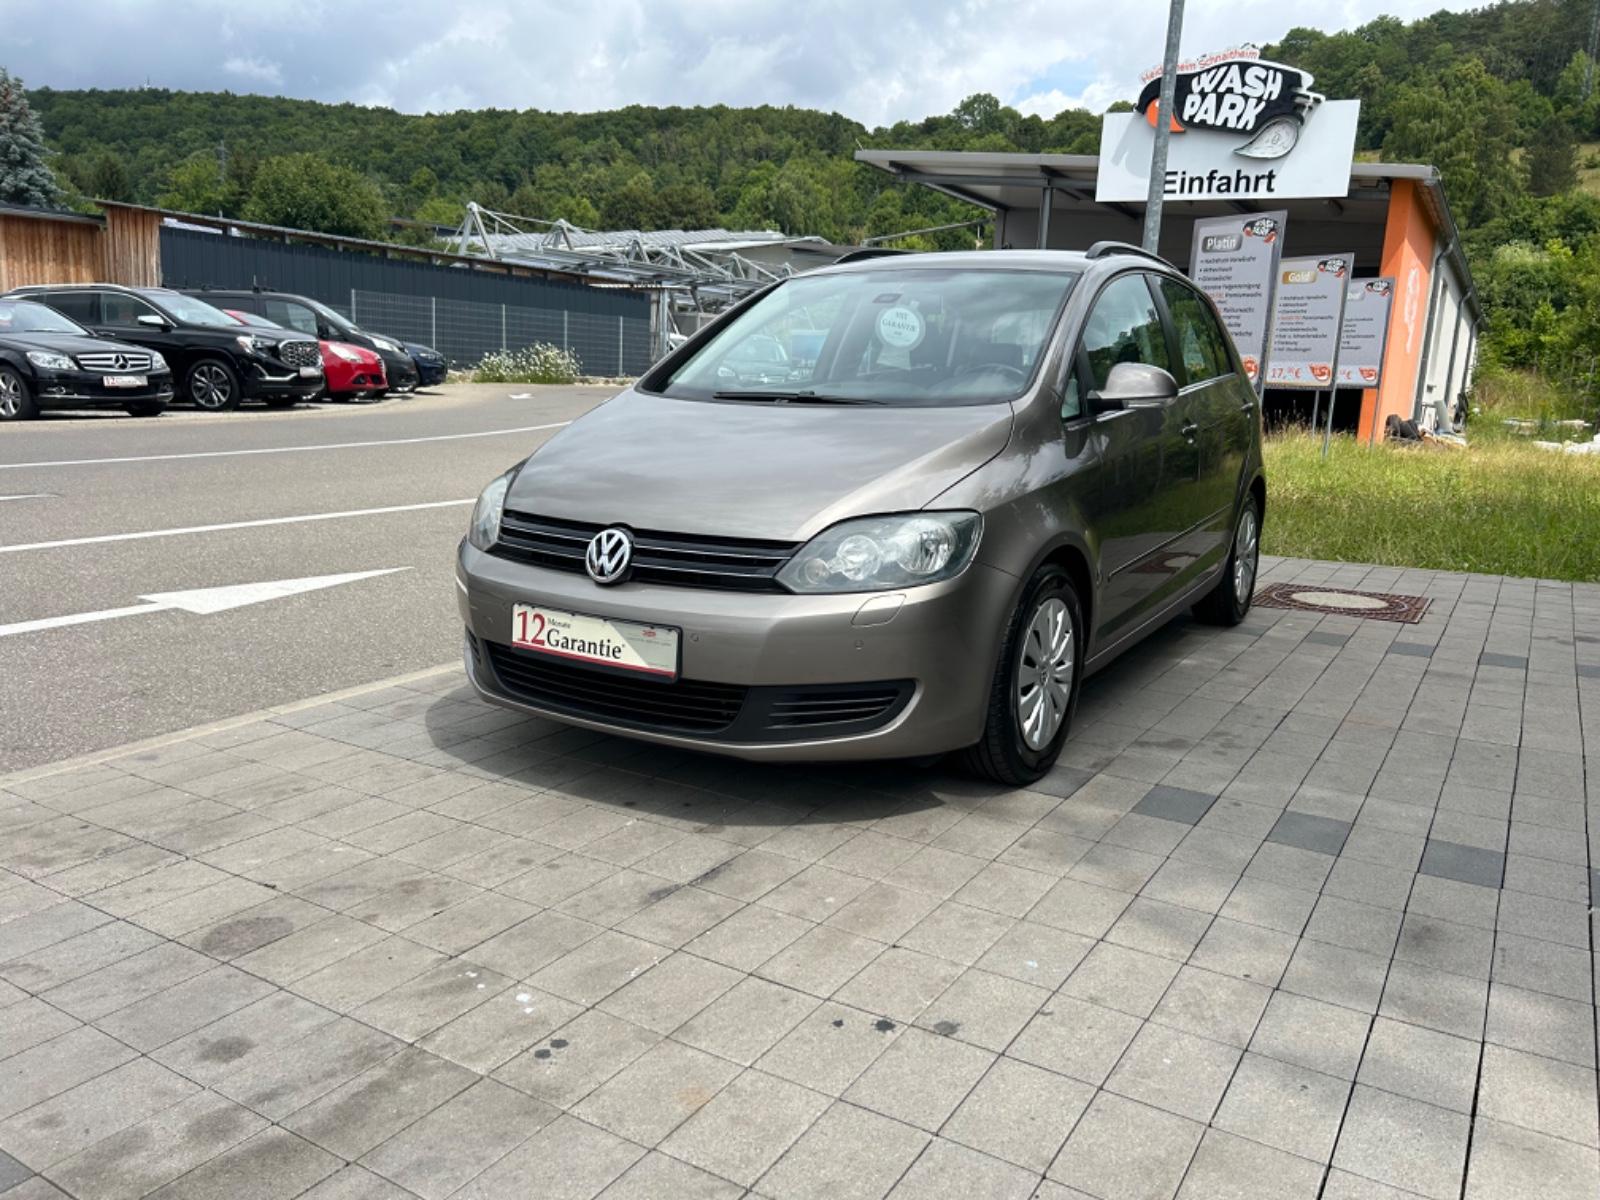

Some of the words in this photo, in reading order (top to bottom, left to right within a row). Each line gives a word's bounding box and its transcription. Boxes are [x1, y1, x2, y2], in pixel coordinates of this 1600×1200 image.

[1199, 50, 1259, 69] Schnaitheim
[1191, 64, 1283, 101] WASH
[1182, 94, 1266, 131] PARK
[1163, 169, 1276, 195] Einfahrt
[1206, 236, 1237, 250] Platin
[1288, 272, 1312, 282] Gold
[517, 611, 545, 646] 12
